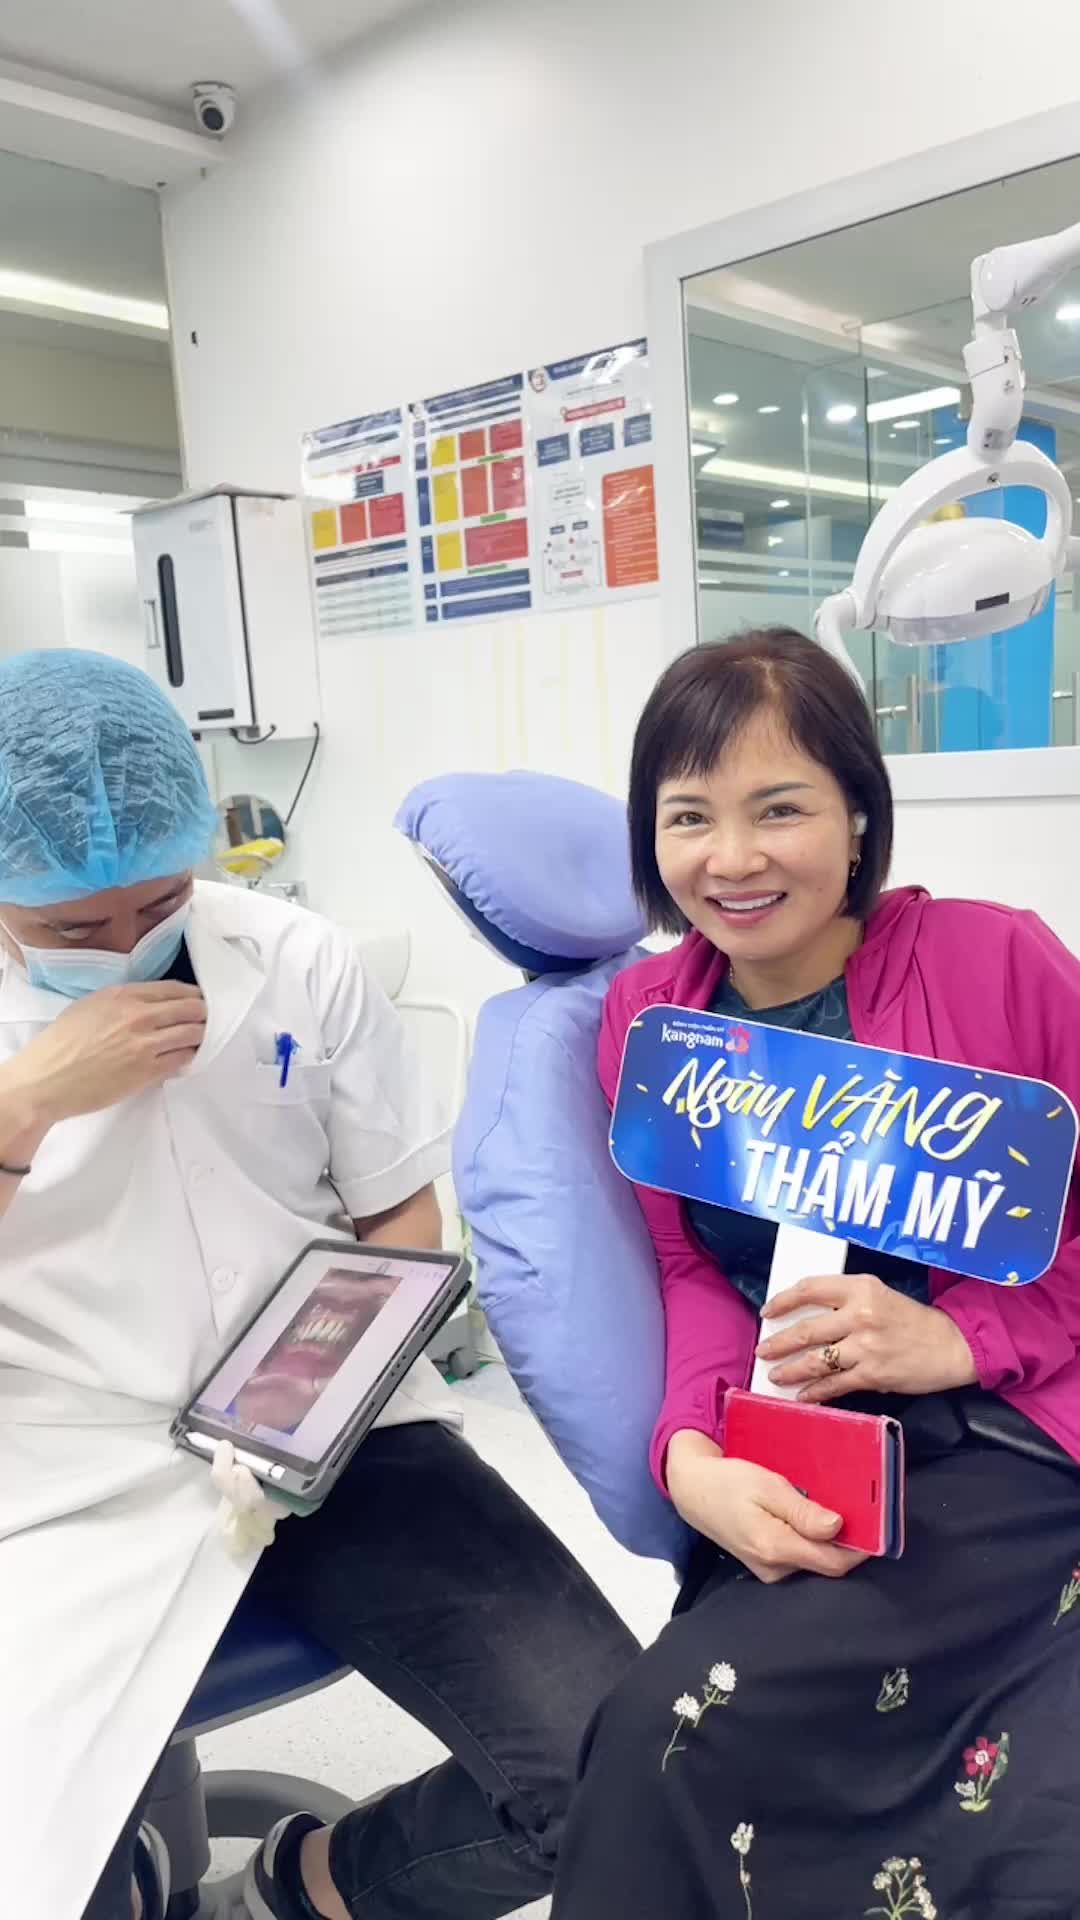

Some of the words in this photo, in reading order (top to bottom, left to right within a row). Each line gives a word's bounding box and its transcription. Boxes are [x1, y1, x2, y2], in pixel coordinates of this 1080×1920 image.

[661, 1023, 724, 1049] kangnam
[662, 1057, 796, 1137] Ngày
[741, 1131, 896, 1229] THẨM
[902, 1169, 1006, 1249] MỸ
